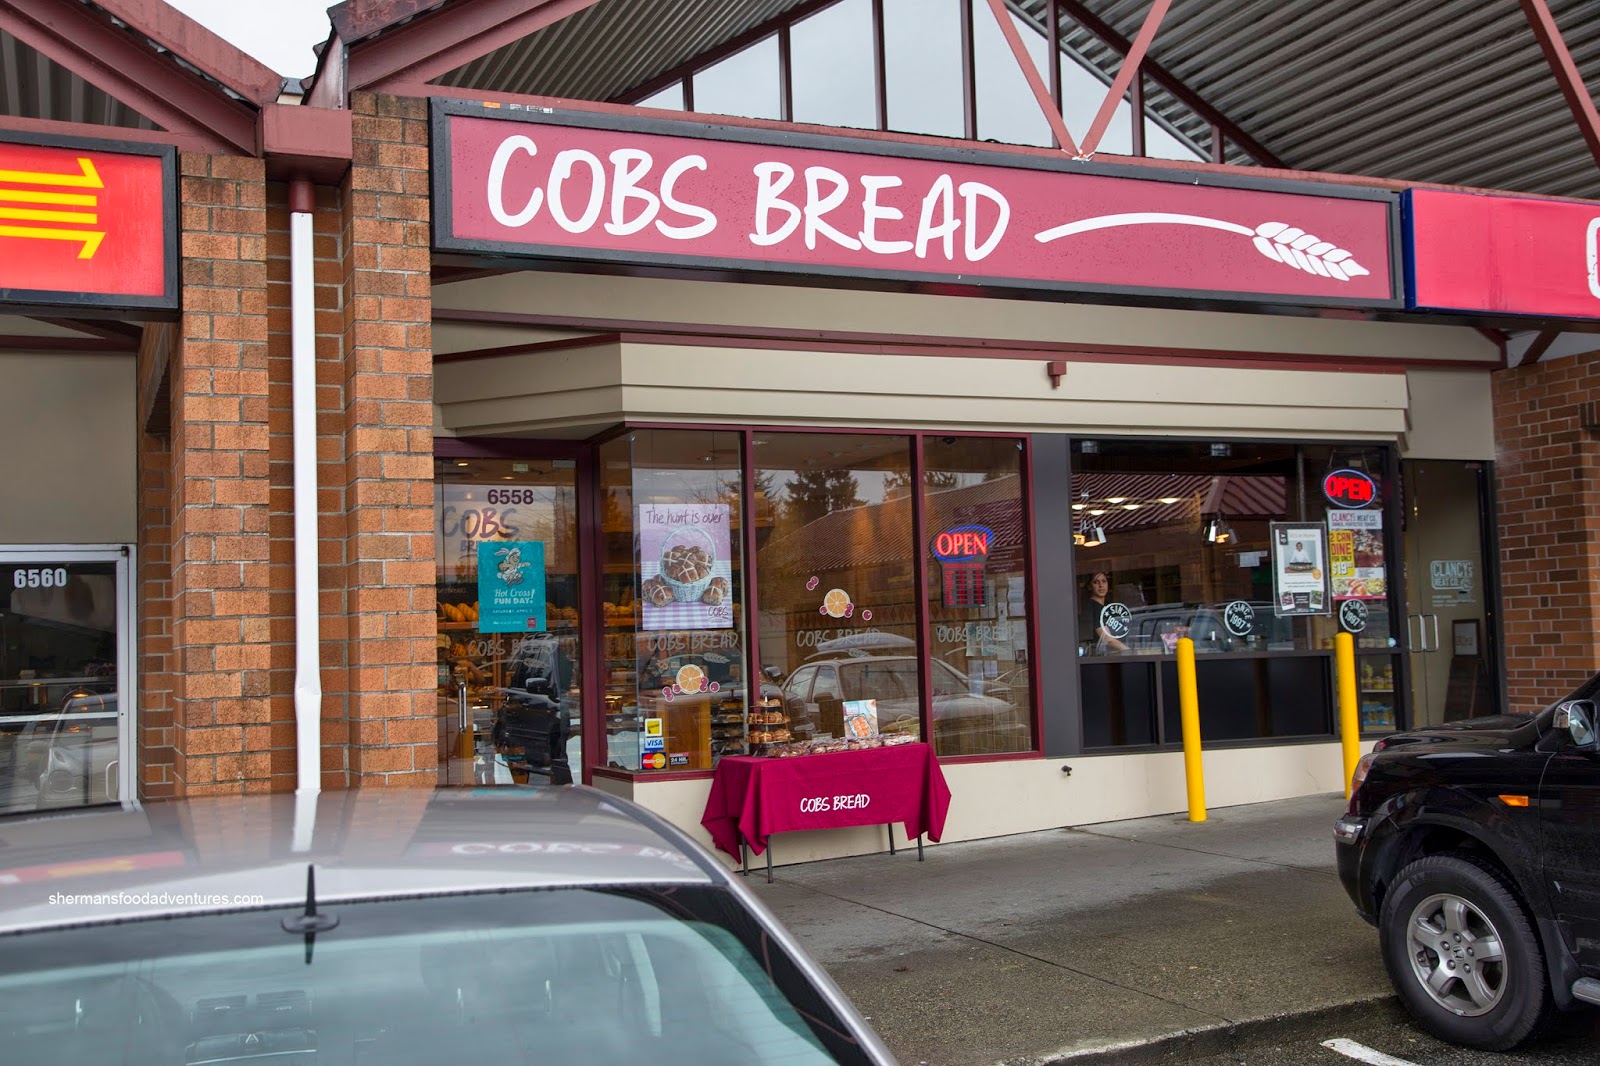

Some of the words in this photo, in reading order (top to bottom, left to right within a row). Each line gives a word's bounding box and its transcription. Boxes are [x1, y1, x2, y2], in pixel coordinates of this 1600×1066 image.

[488, 135, 718, 240] COBS
[750, 161, 1011, 262] BREAD
[1326, 476, 1372, 500] OPEN
[487, 489, 534, 505] 6558
[440, 506, 519, 538] COBS
[646, 509, 664, 524] The
[667, 508, 687, 524] hunt
[692, 510, 700, 524] is
[703, 513, 724, 524] over
[936, 532, 987, 555] OPEN
[1336, 532, 1351, 542] CAN
[1331, 543, 1352, 555] DINE
[14, 568, 67, 588] 6560
[494, 588, 508, 598] Hot
[510, 588, 531, 597] Cross
[494, 597, 511, 605] FUN
[708, 606, 729, 616] COBS
[1110, 605, 1129, 623] SINCE
[1233, 603, 1252, 620] SINCE
[1348, 601, 1366, 618] SINCE
[1106, 616, 1123, 632] 1997
[1230, 613, 1246, 629] 1997
[1345, 611, 1361, 627] 1997
[648, 633, 686, 651] COBS
[691, 631, 739, 650] BREAD
[796, 629, 829, 647] COBS
[836, 627, 881, 645] BREAD
[938, 626, 970, 643] COBS
[467, 639, 506, 657] COBS
[800, 797, 831, 812] COBS
[833, 794, 870, 810] BREAD
